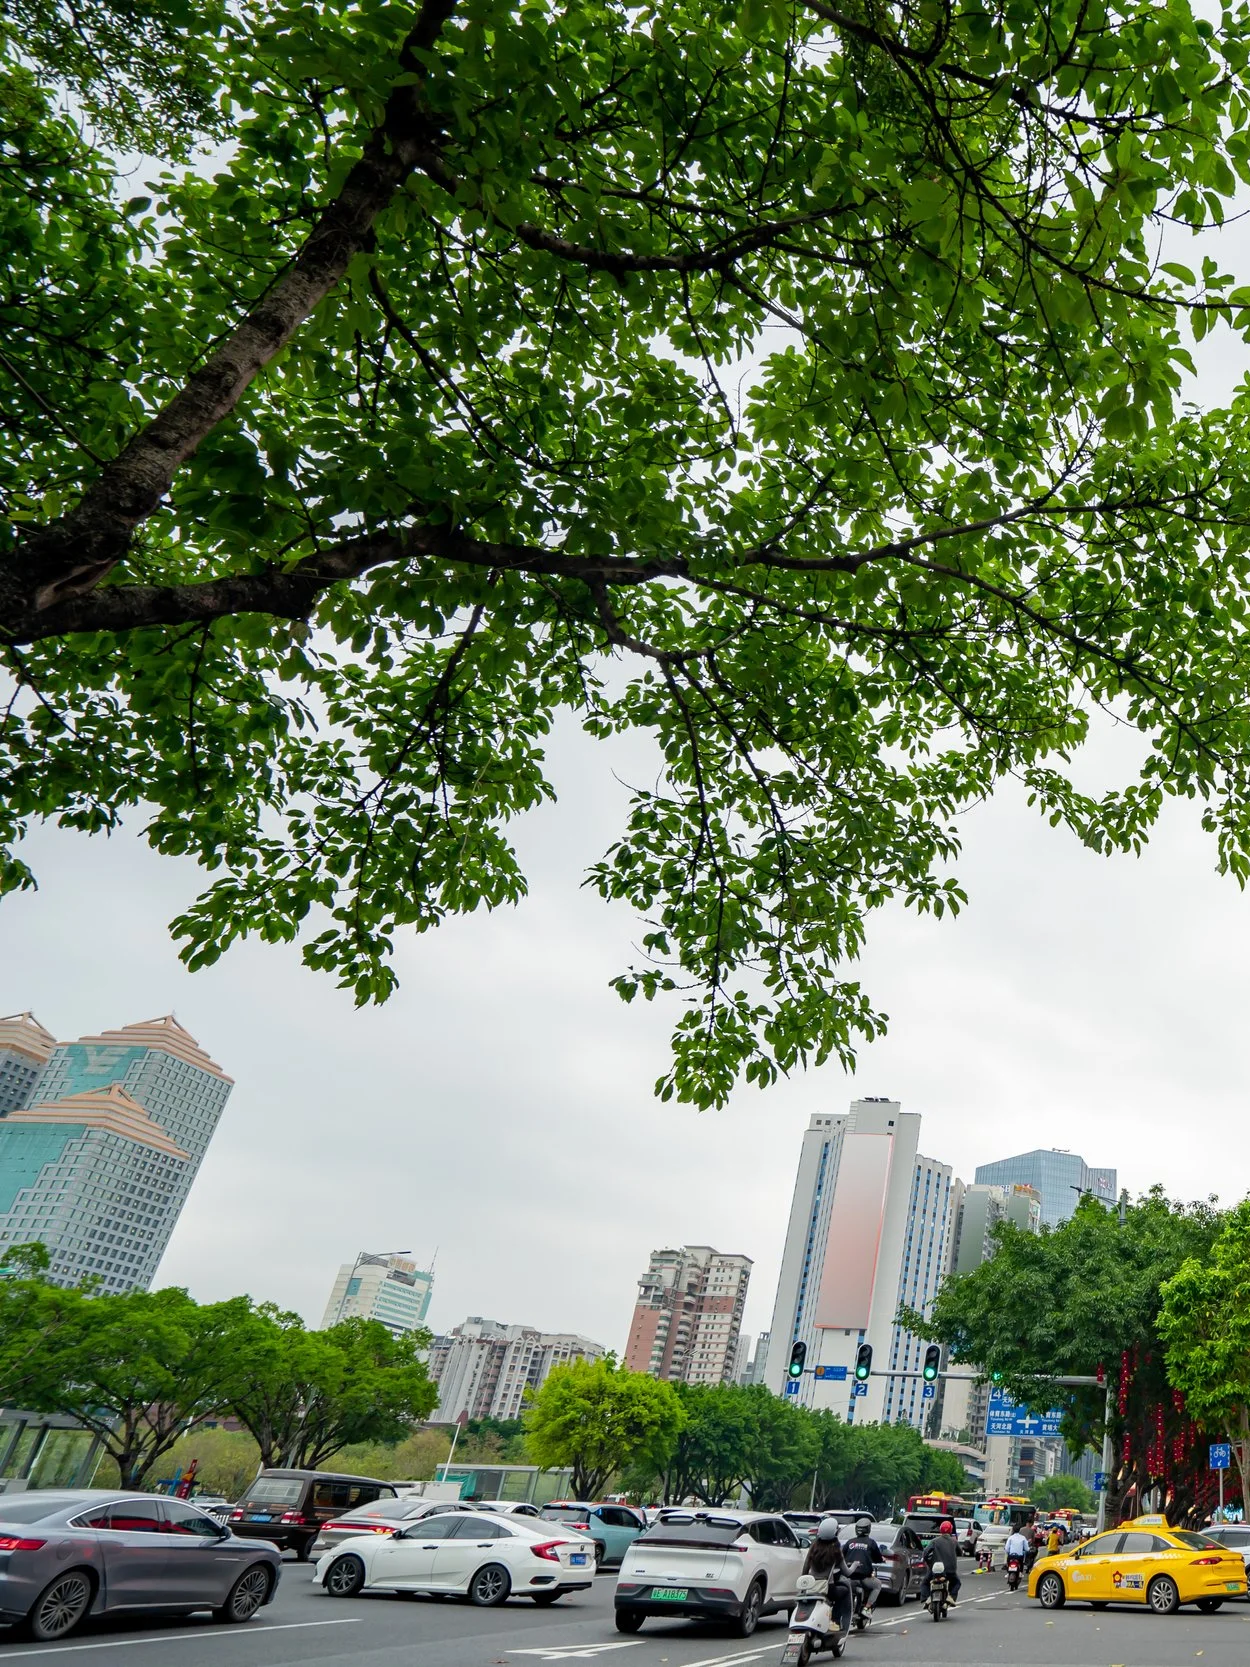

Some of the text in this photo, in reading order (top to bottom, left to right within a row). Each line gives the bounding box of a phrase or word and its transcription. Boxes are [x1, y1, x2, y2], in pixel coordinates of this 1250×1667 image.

[791, 1383, 796, 1394] 1
[857, 1385, 865, 1395] 2
[924, 1387, 933, 1397] 3
